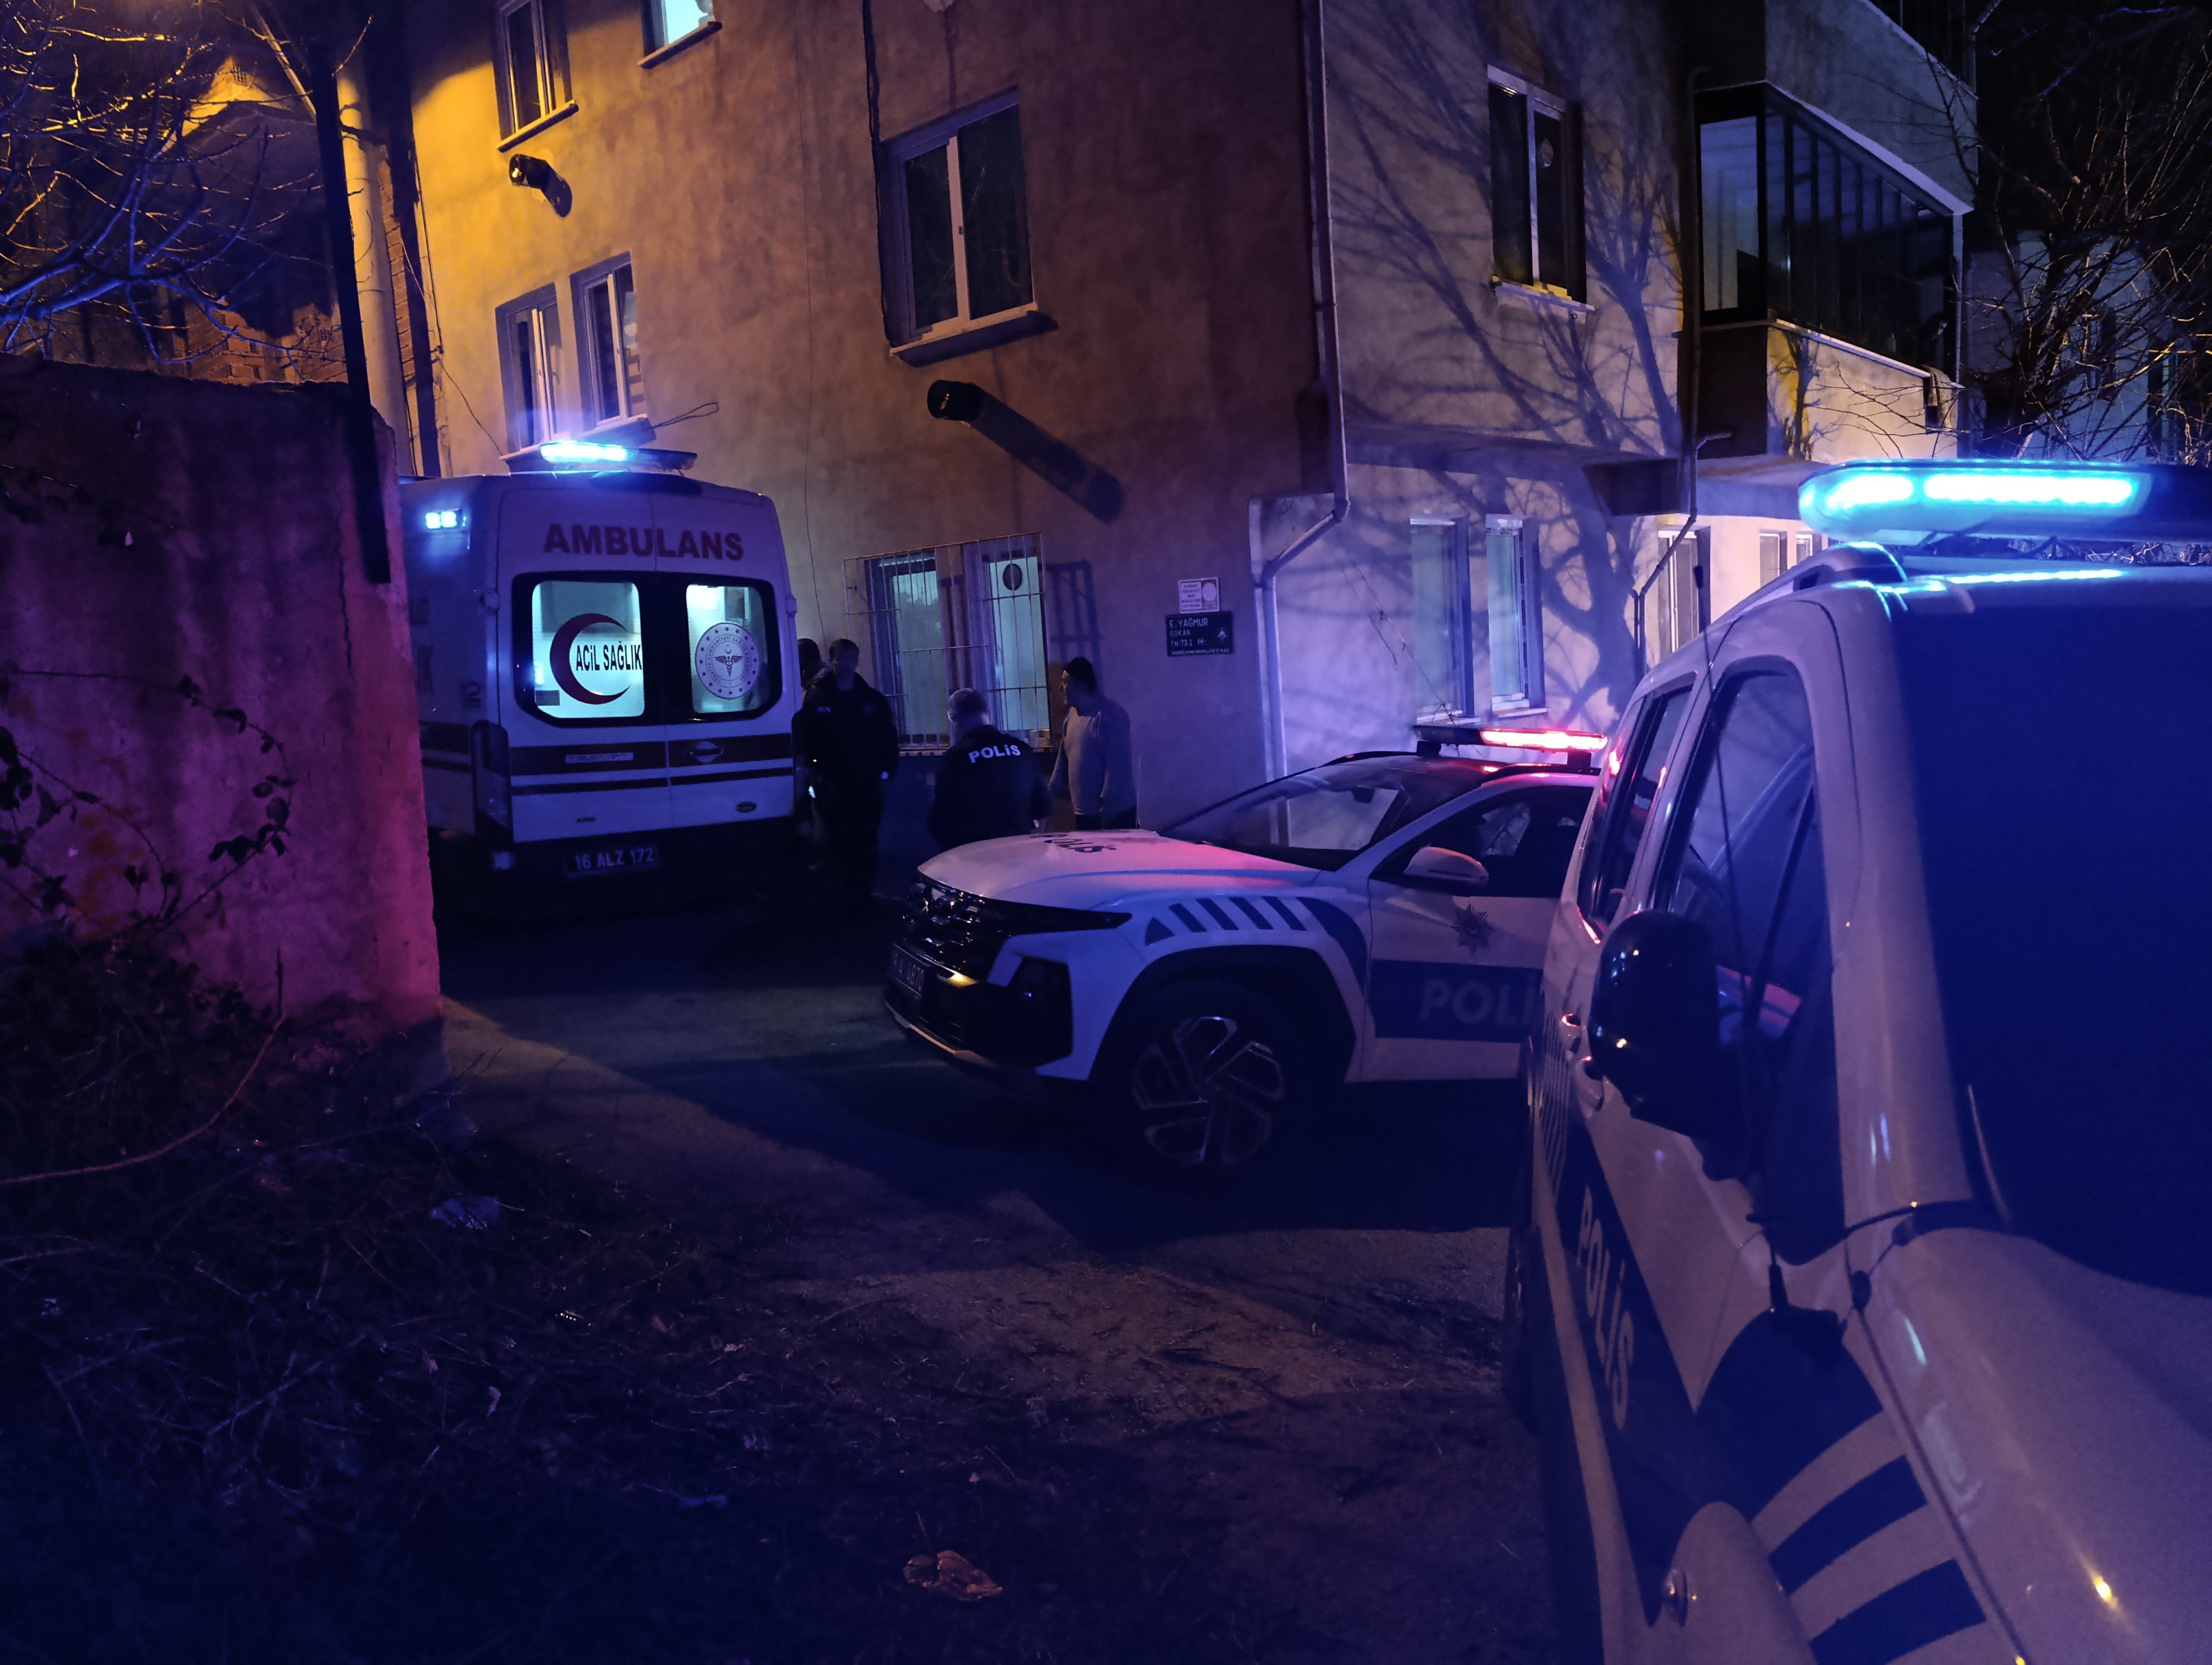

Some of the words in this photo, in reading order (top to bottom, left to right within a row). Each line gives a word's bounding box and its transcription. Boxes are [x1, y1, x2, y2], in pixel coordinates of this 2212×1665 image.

[543, 523, 744, 561] AMBULANS
[603, 641, 642, 670] SAĞLIK
[574, 854, 591, 870] 16
[596, 850, 625, 868] ALZ
[629, 847, 655, 864] 172
